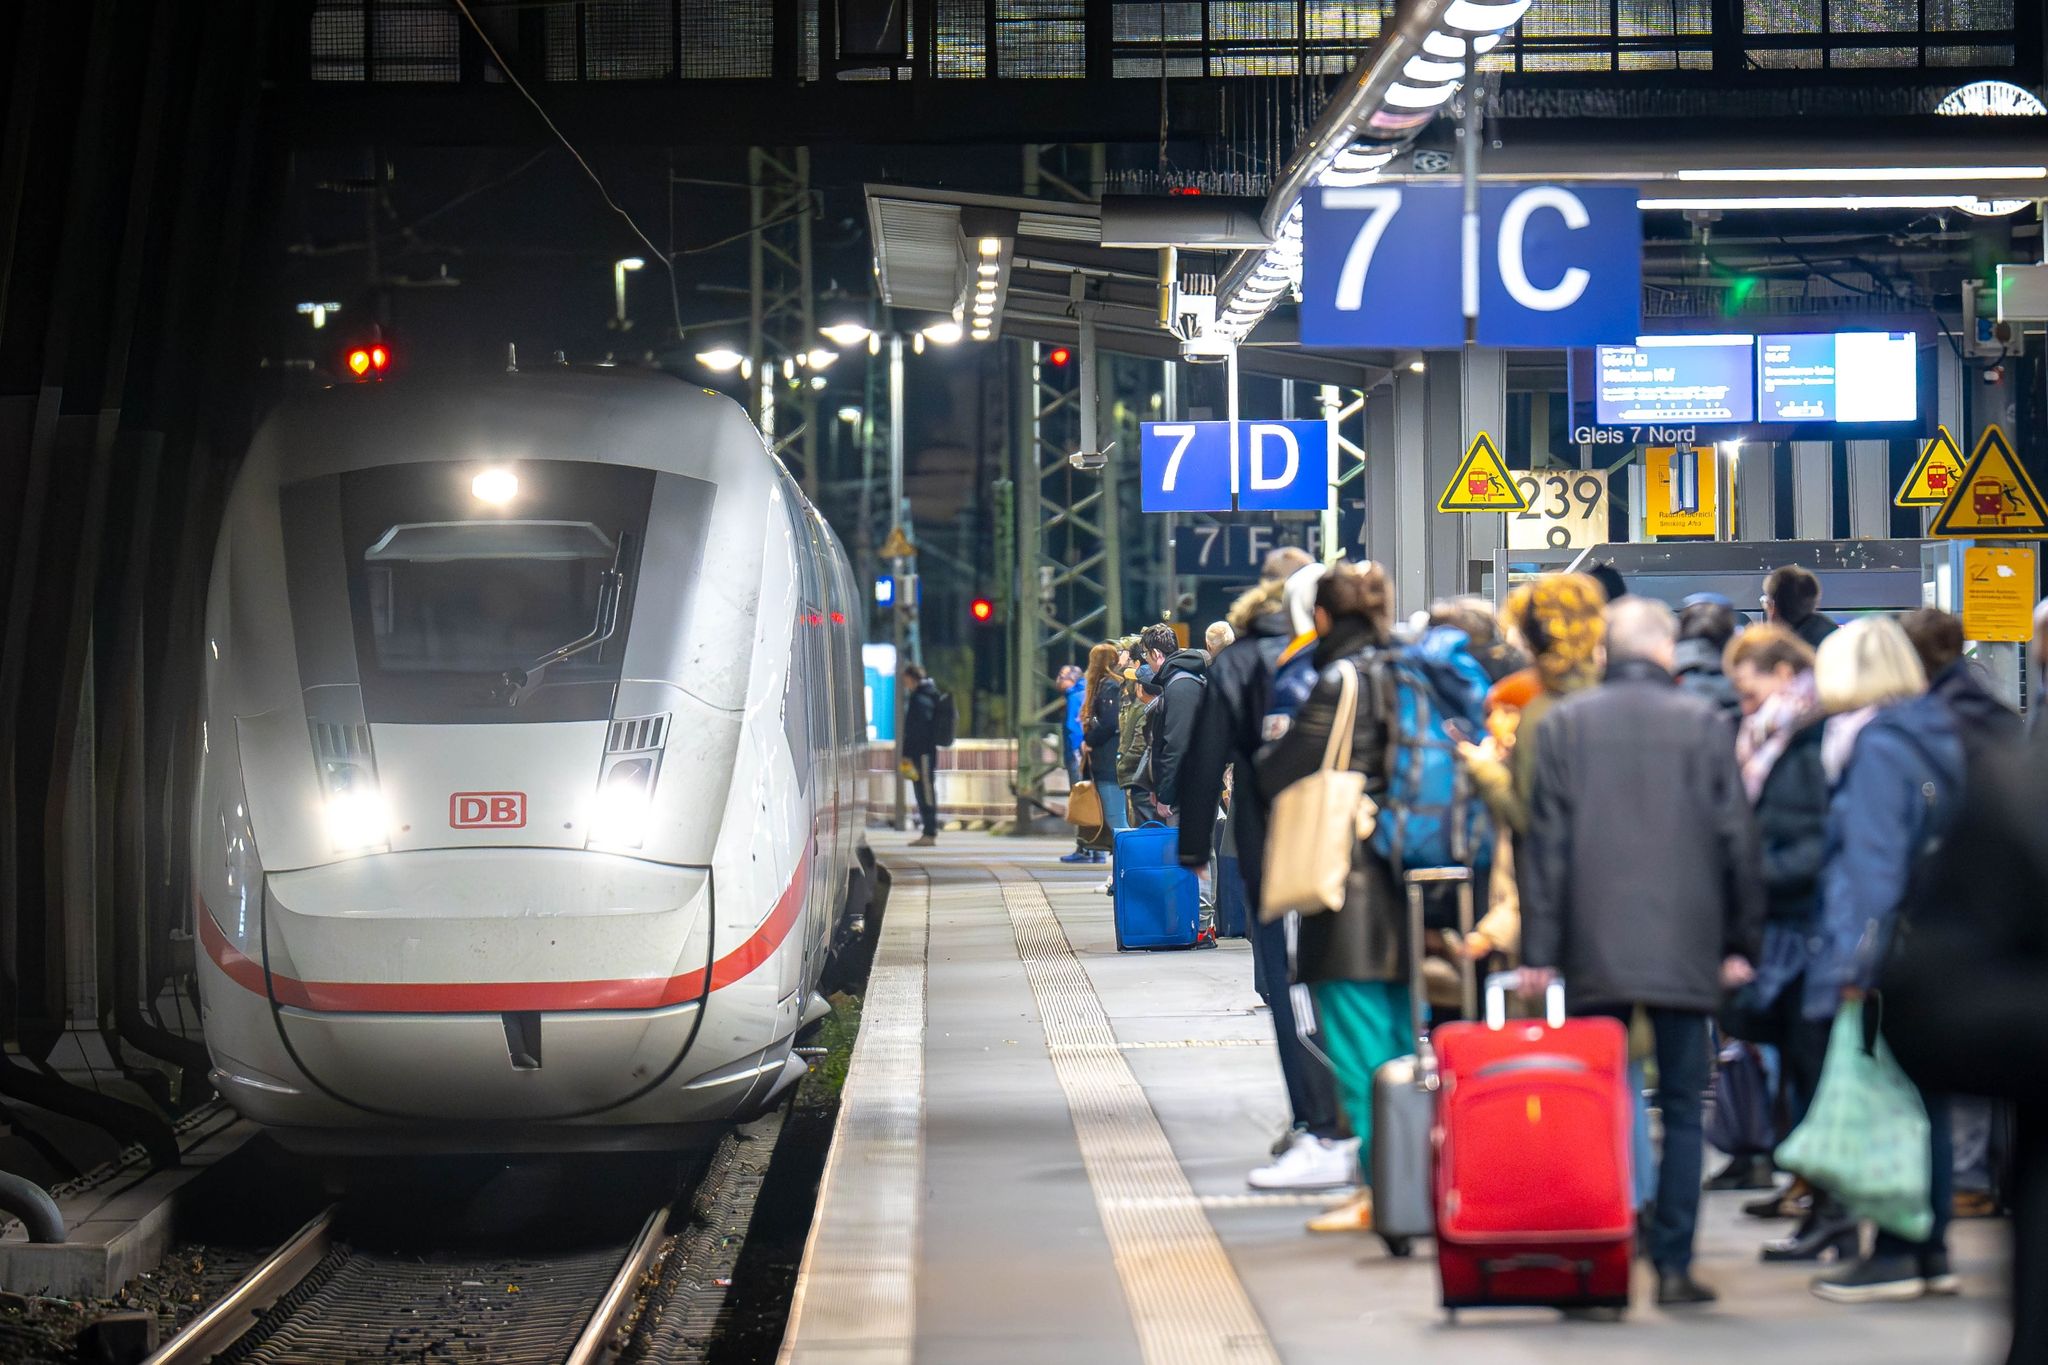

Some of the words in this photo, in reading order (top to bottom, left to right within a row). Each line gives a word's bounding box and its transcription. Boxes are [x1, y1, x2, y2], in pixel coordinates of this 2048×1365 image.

[1321, 187, 1402, 311] 7
[1497, 185, 1591, 312] C
[1574, 426, 1624, 444] Gleis
[1630, 426, 1642, 443] 7
[1649, 425, 1697, 443] Nord
[1153, 424, 1196, 492] 7
[1250, 424, 1300, 490] D
[1516, 475, 1603, 520] 239
[1194, 527, 1221, 567] 7
[1249, 526, 1274, 566] F
[459, 797, 518, 823] DB
